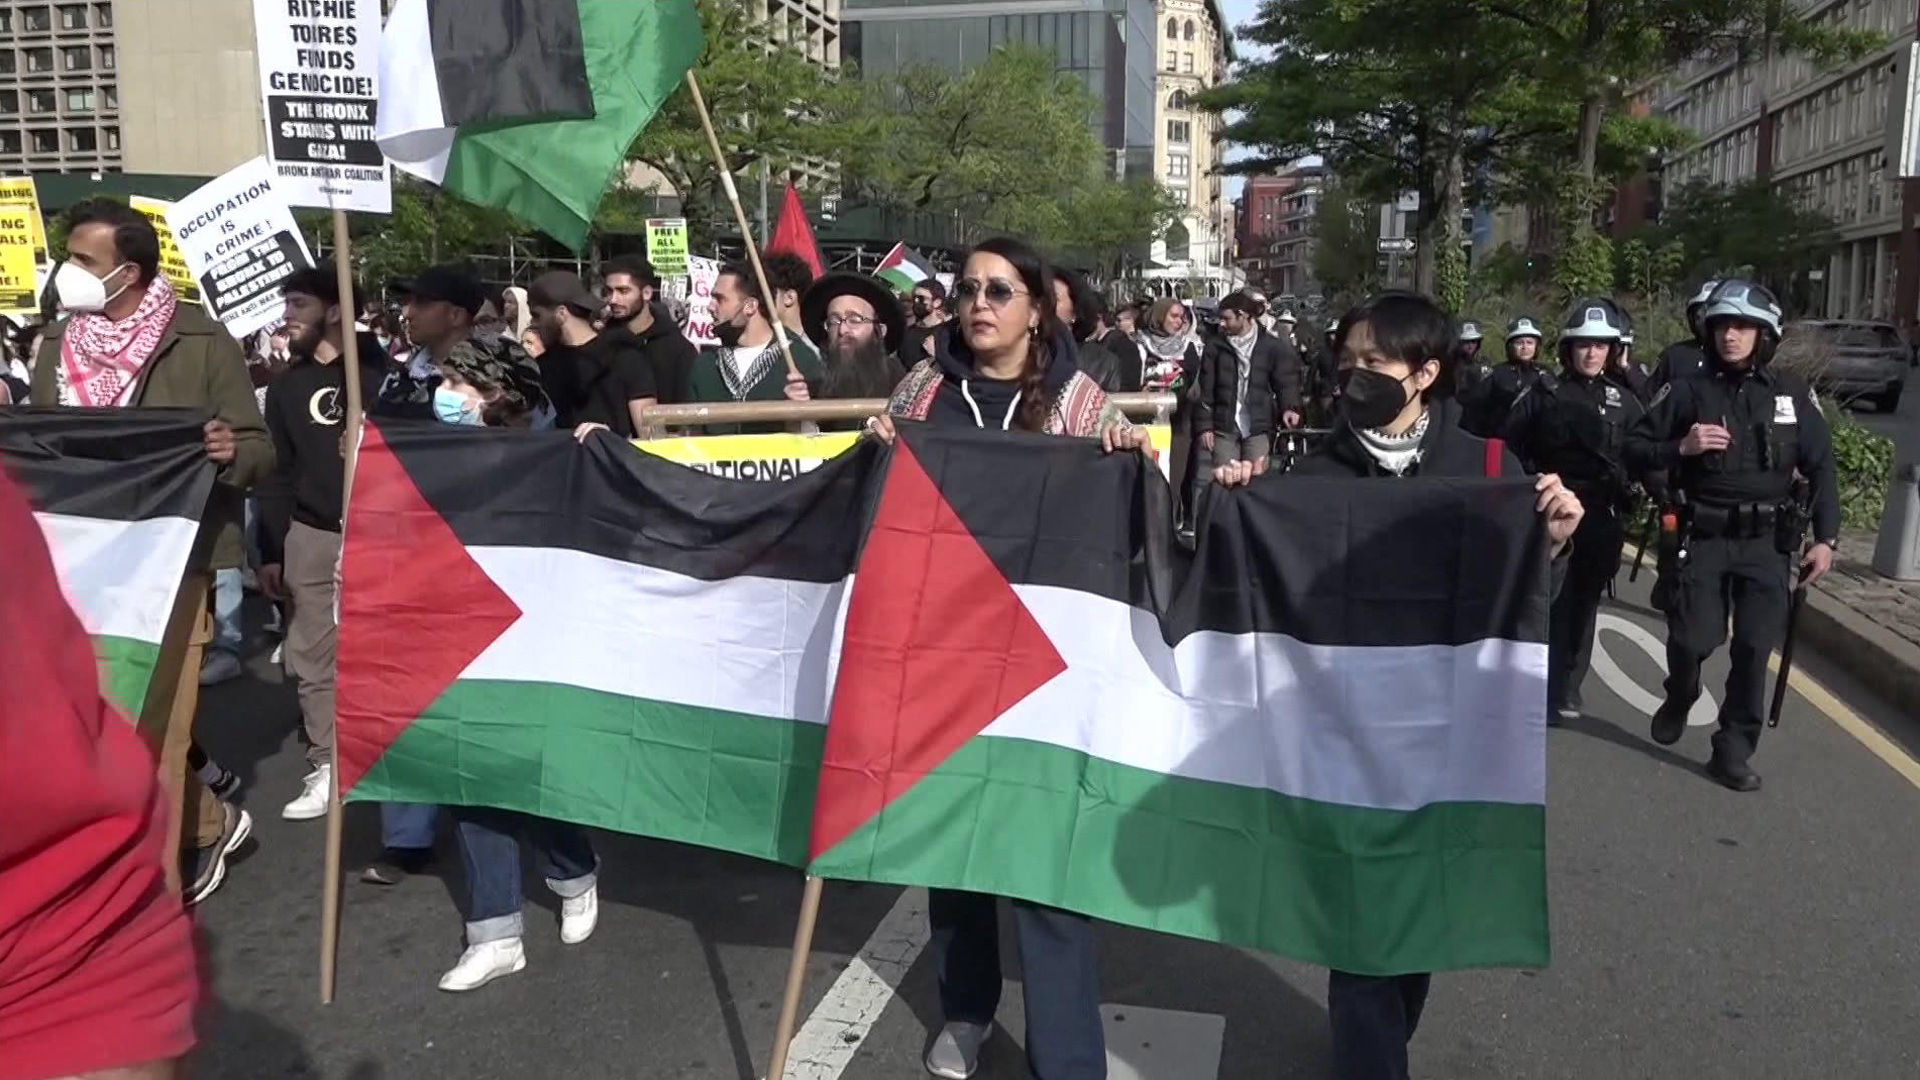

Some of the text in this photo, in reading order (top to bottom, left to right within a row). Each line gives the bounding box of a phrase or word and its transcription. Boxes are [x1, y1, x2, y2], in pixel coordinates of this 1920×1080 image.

[288, 0, 356, 19] RICHIE
[297, 49, 355, 70] FUNDS
[270, 71, 373, 96] GENOCIDE!
[285, 101, 314, 119] THE
[179, 179, 271, 240] OCCUPATION
[220, 219, 236, 235] IS
[654, 228, 680, 237] FREE
[657, 238, 675, 247] ALL
[203, 251, 214, 264] A
[266, 250, 286, 267] TO
